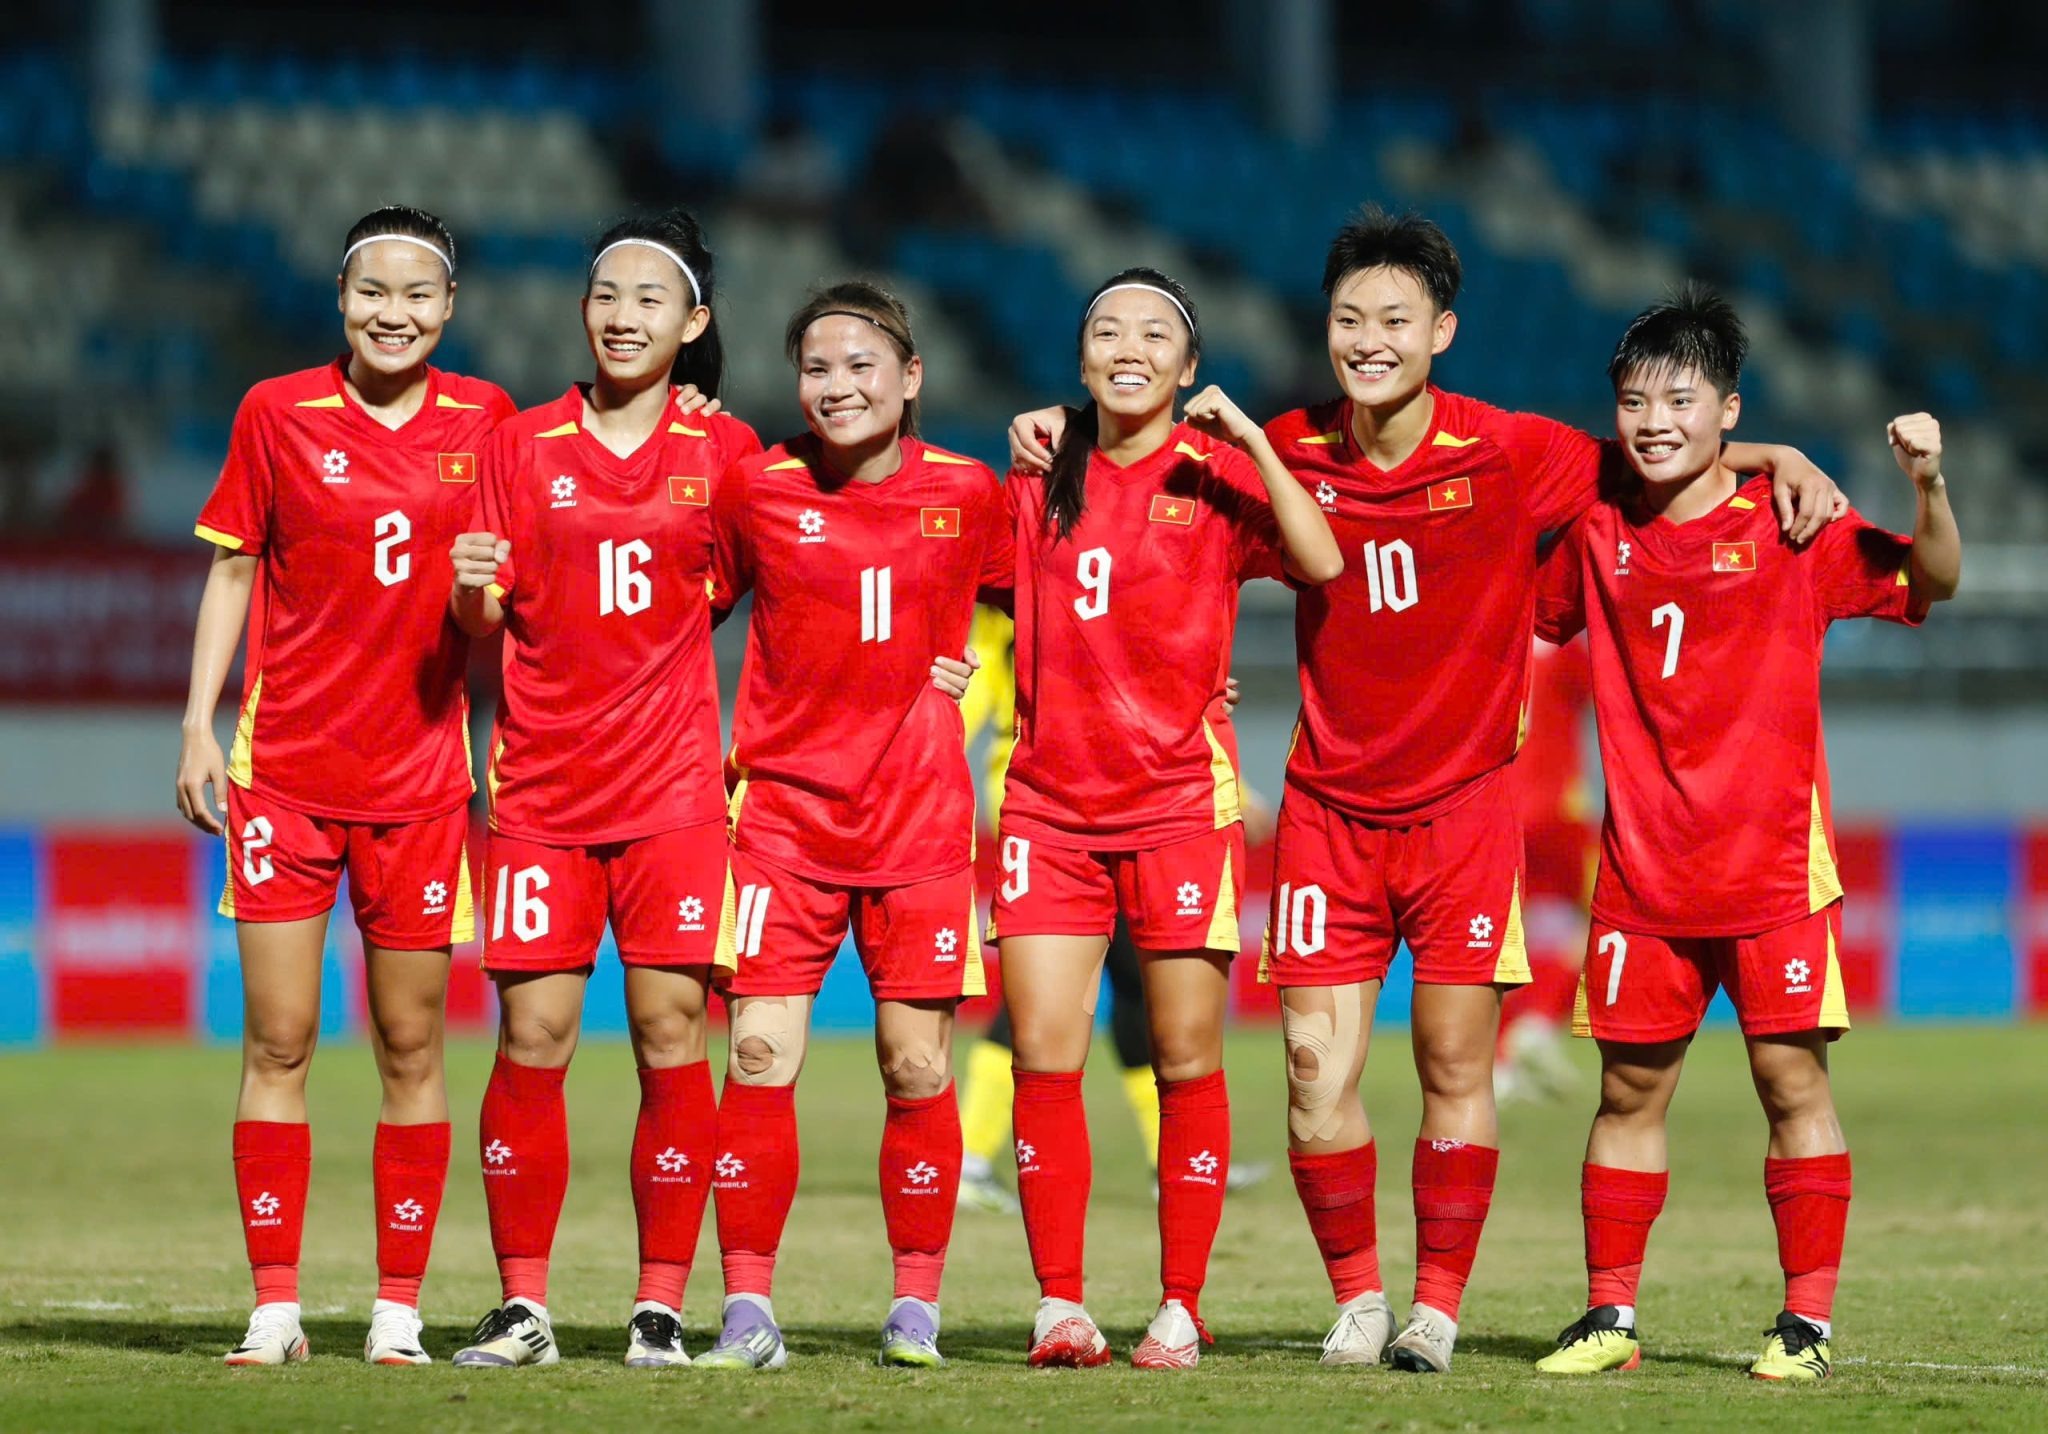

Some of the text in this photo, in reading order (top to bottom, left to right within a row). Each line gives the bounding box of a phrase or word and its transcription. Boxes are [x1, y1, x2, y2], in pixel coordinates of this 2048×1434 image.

[375, 511, 411, 586] 2
[599, 539, 652, 616] 16
[1074, 547, 1112, 620] 9
[1363, 538, 1419, 613] 10
[860, 566, 891, 642] 11
[1651, 602, 1685, 679] 7
[243, 816, 274, 886] 2
[1001, 835, 1030, 903] 9
[492, 864, 550, 942] 16
[736, 884, 772, 958] 11
[1276, 883, 1327, 957] 10
[1599, 931, 1627, 1005] 7
